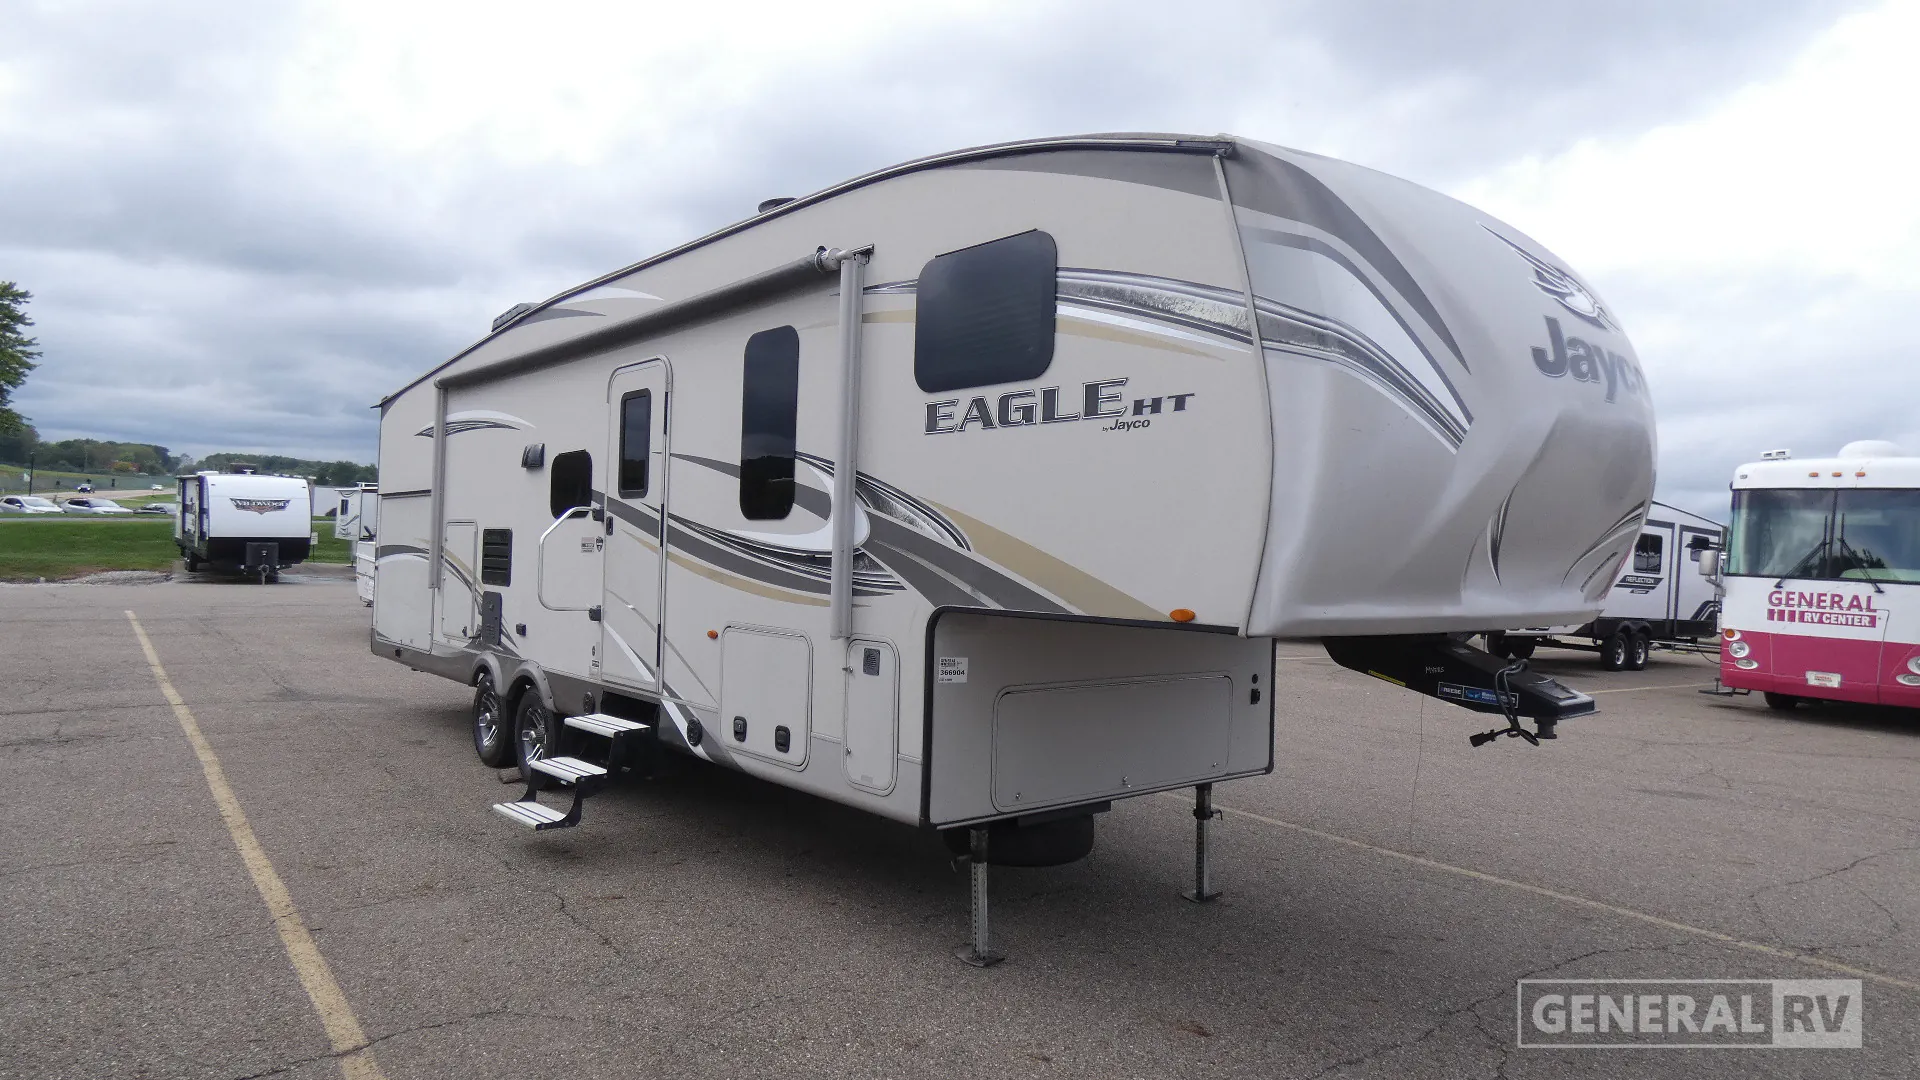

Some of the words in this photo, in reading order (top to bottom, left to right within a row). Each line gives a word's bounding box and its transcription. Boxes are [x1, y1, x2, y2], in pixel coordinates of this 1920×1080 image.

[924, 377, 1128, 435] EAGLE
[1132, 393, 1195, 416] HT
[1110, 418, 1151, 432] Jayco
[1767, 590, 1877, 612] GENERAL
[1803, 612, 1819, 623] RV
[1822, 613, 1871, 626] CENTER
